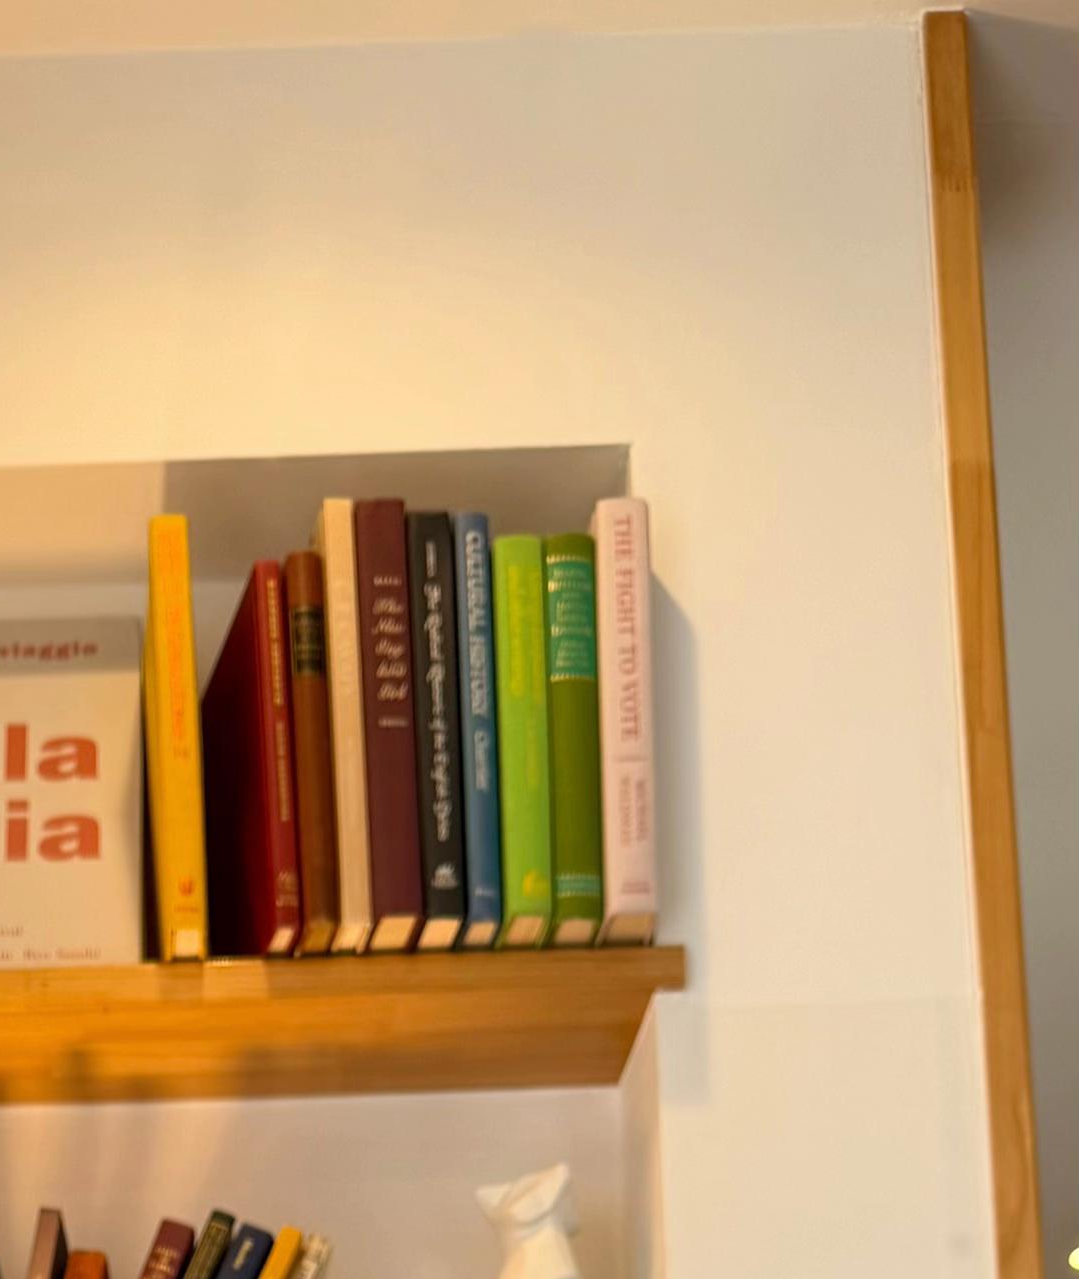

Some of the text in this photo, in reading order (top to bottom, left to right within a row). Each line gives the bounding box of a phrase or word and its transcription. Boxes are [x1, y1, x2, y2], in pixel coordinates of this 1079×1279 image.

[465, 530, 487, 633] CULTURAL
[615, 514, 640, 742] THE FIGHT TO VOTE
[469, 635, 489, 717] HISTORY
